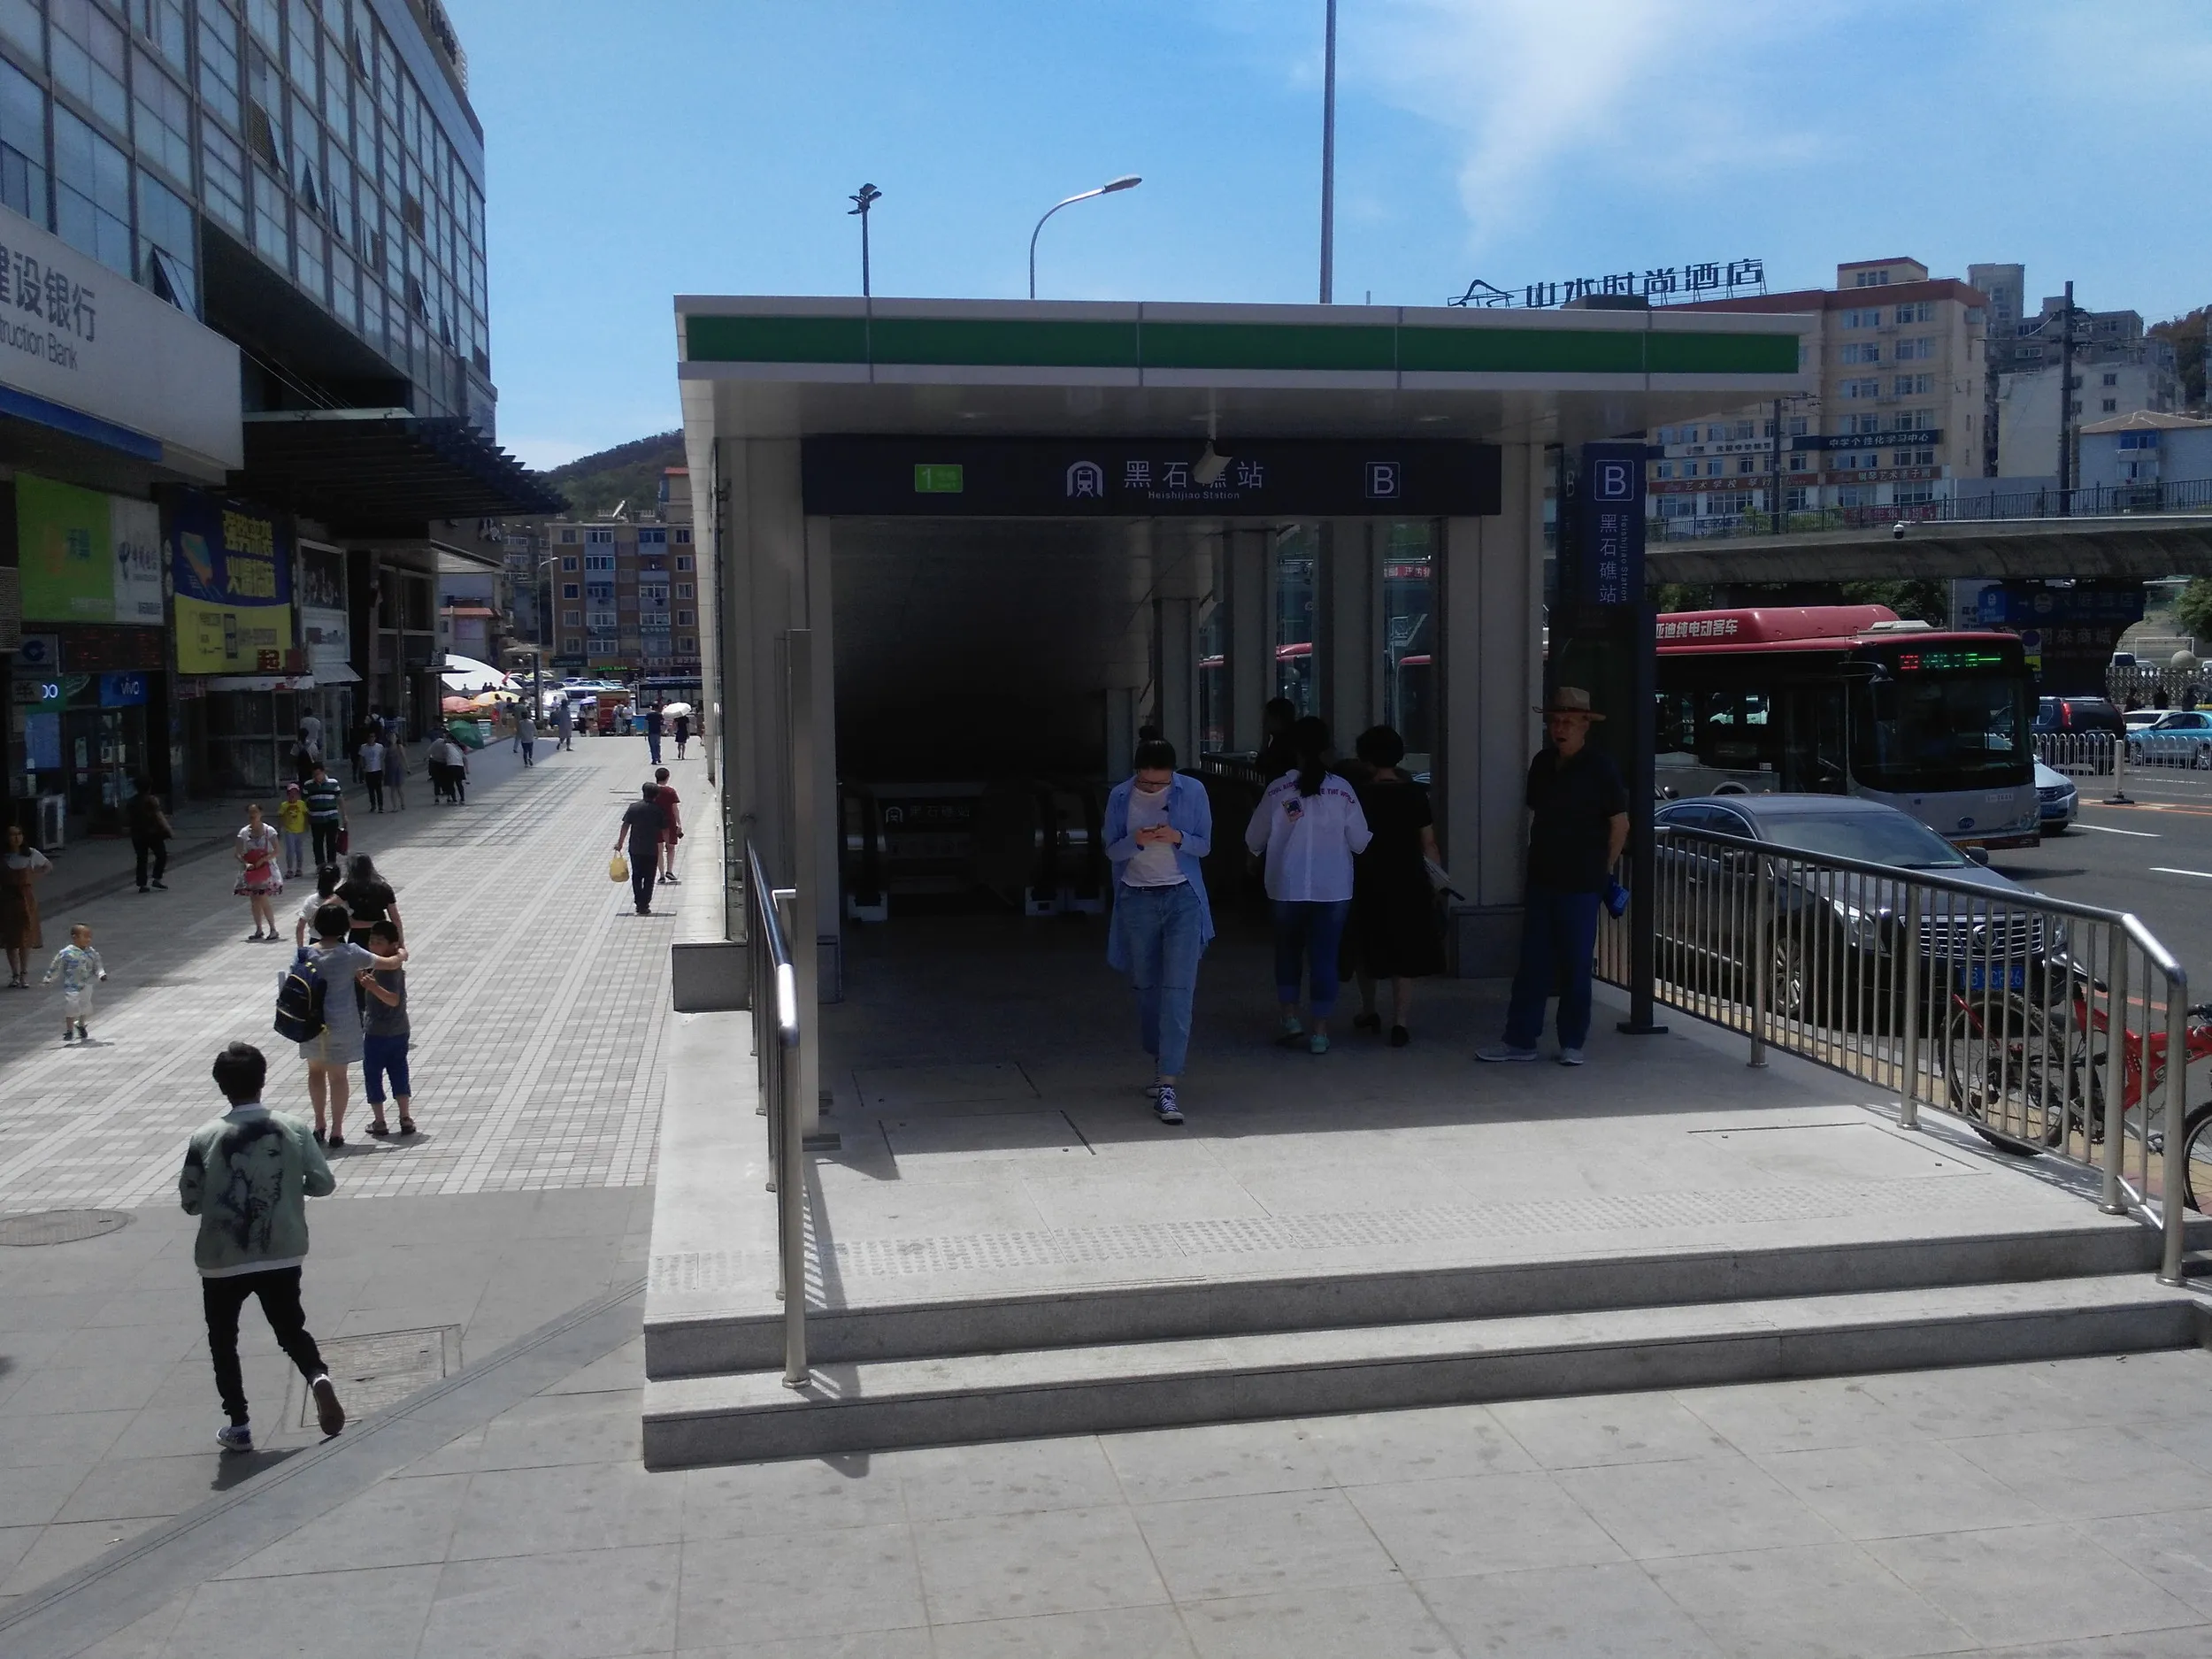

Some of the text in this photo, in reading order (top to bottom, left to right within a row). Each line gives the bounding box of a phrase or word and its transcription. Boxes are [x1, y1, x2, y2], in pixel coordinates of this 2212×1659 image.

[1526, 258, 1762, 308] 山水时尚酒店
[48, 333, 78, 372] Bank
[1829, 434, 1929, 447] 中学个性化学习中心
[1373, 465, 1394, 495] B
[1604, 465, 1626, 495] B
[1685, 479, 1737, 492] 艺术学校
[1148, 490, 1240, 501] Heishijiao Station
[1600, 514, 1618, 603] 黑石礁站
[1620, 514, 1629, 602] Heishijiao Station
[120, 677, 140, 695] vivo
